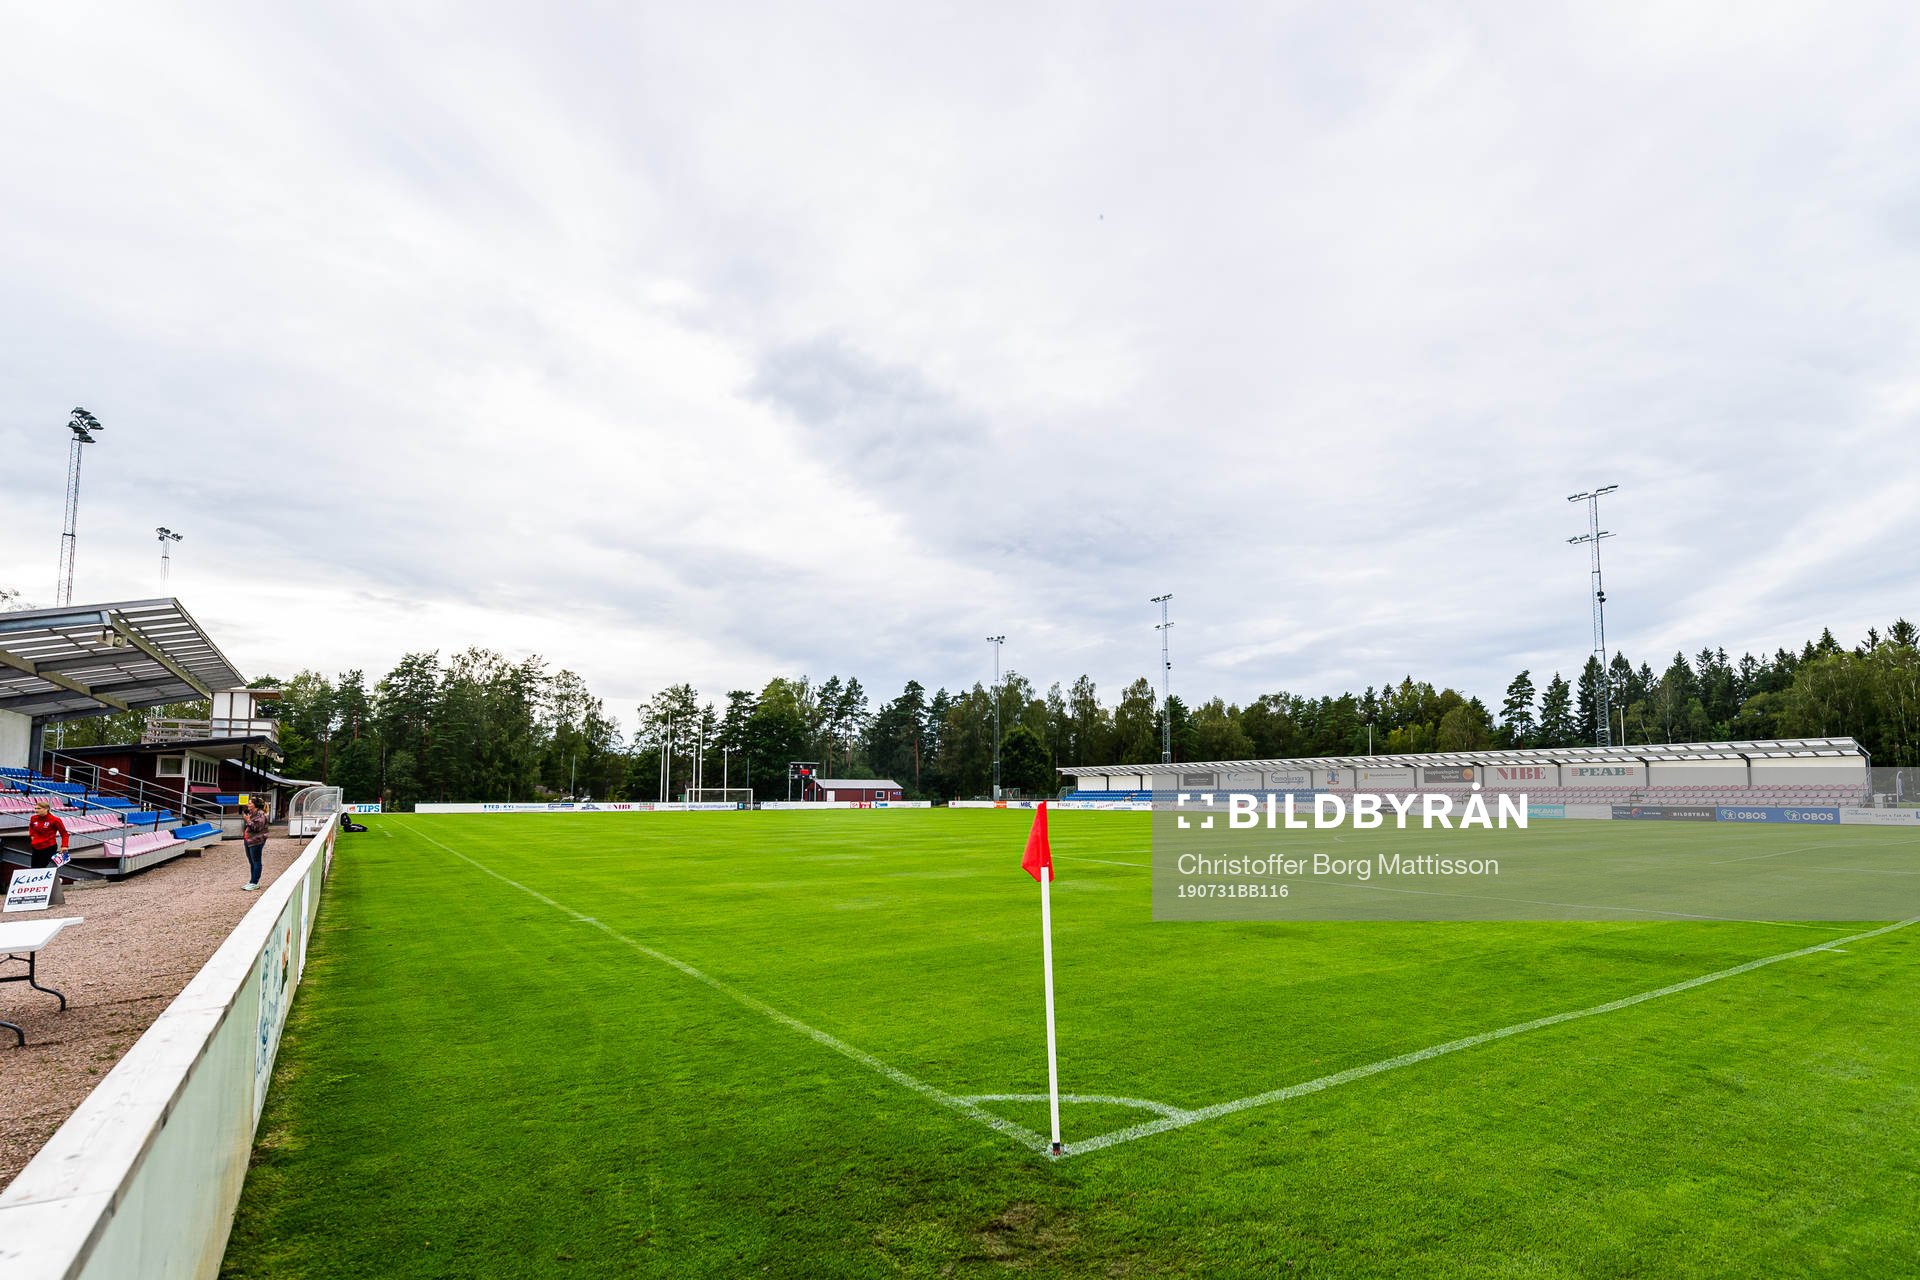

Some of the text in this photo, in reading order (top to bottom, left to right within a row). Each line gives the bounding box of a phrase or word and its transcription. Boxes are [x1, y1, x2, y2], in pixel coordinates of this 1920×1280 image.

[1496, 767, 1546, 780] NIBE
[1578, 767, 1627, 777] PEAB
[356, 804, 380, 813] TIPS
[1737, 811, 1767, 820] OBOS
[1801, 812, 1834, 821] OBOS
[13, 870, 53, 886] Kiosk
